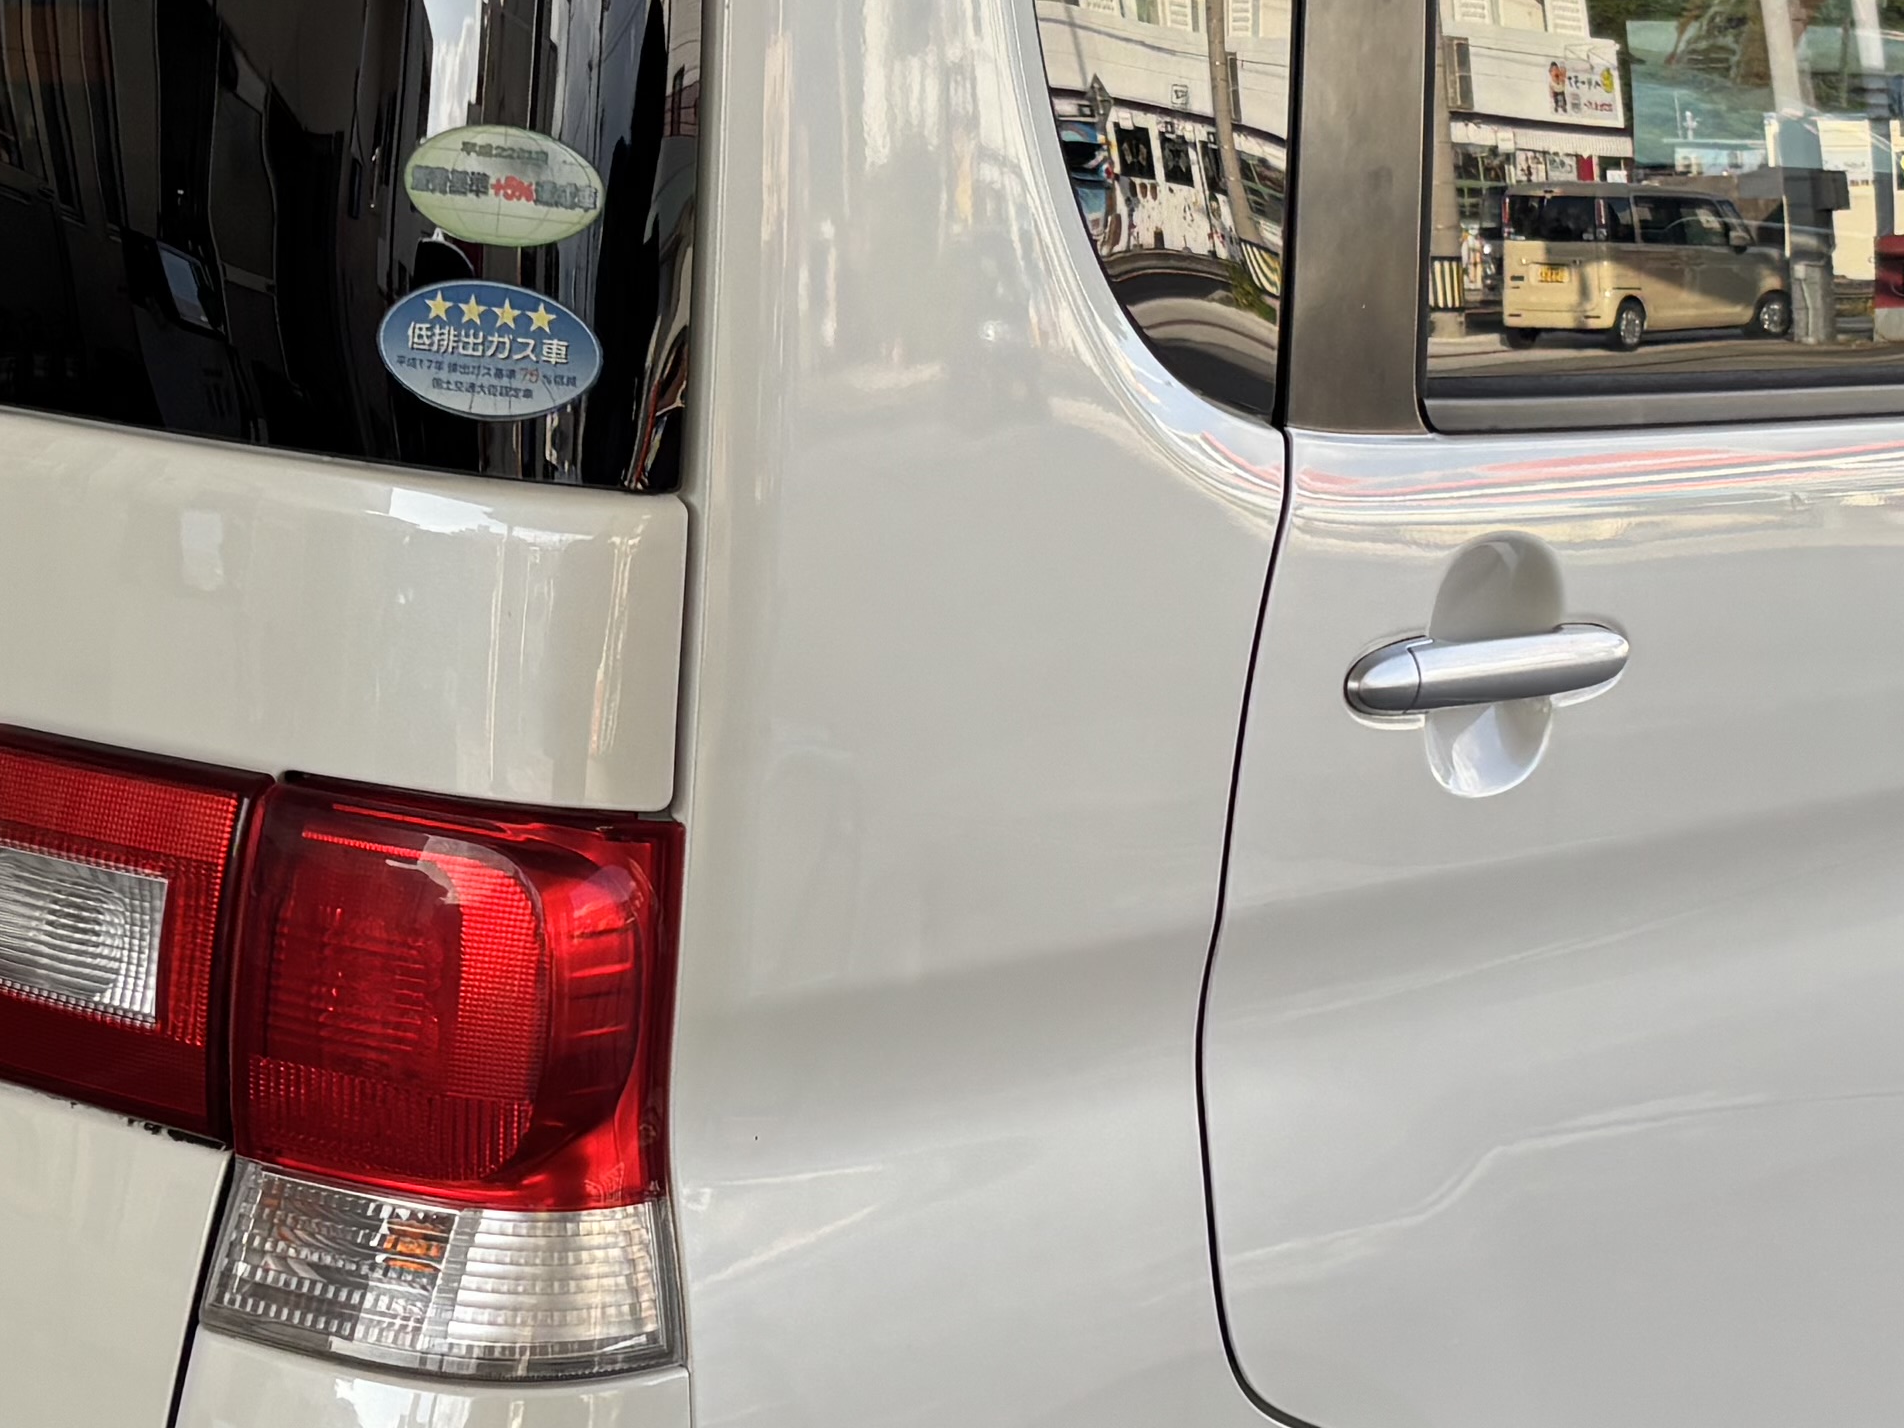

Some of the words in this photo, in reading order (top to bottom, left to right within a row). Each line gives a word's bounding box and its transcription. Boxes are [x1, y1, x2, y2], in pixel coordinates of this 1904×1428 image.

[407, 321, 571, 366] 低排出ガス車
